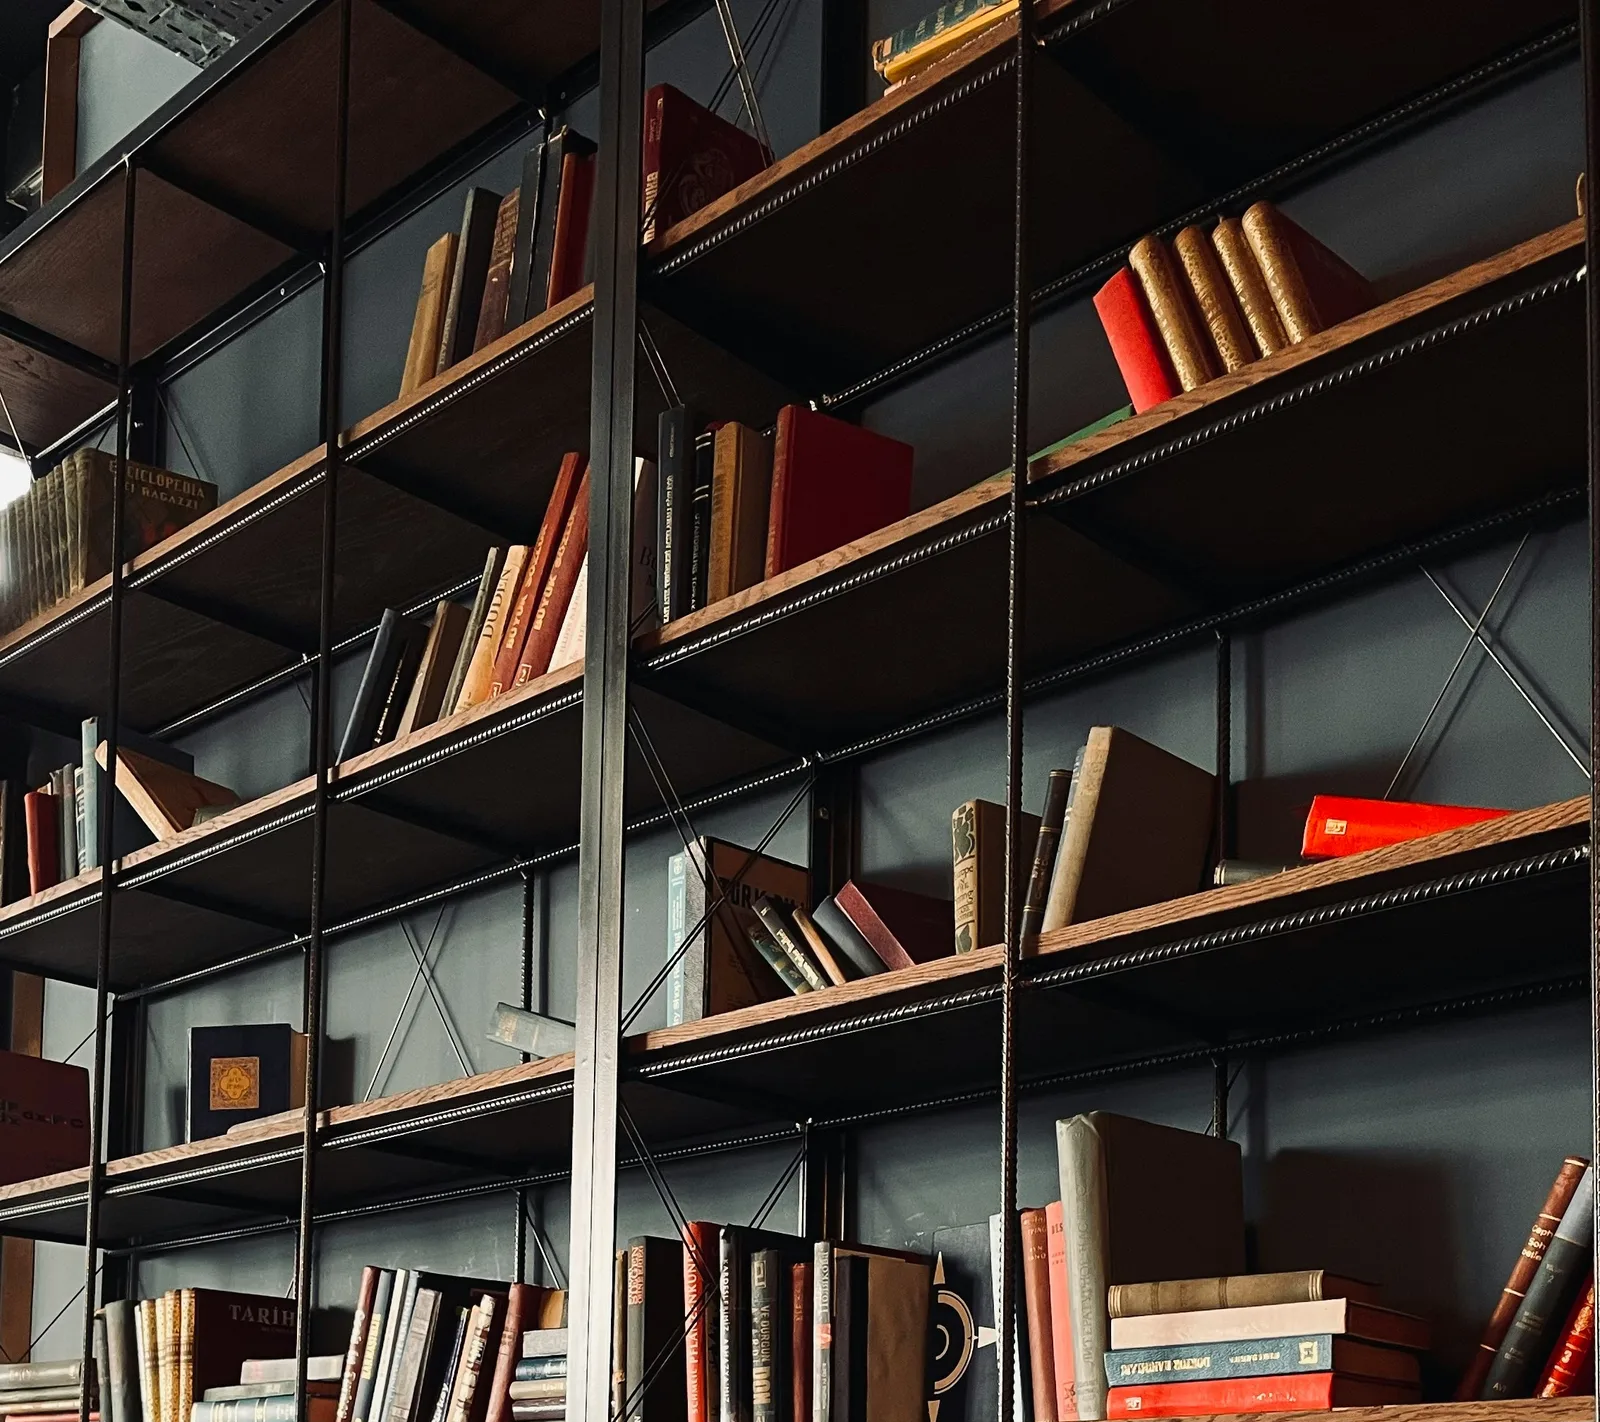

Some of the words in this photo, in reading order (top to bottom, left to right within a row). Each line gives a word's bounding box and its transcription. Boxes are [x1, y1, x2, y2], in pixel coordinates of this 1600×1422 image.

[109, 460, 205, 498] ECICLOPEDIA
[142, 486, 198, 510] RAGAZZI
[482, 568, 512, 639] DUDEN
[229, 1303, 296, 1327] TARİH
[1561, 1351, 1573, 1364] 3
[753, 1367, 771, 1405] DON
